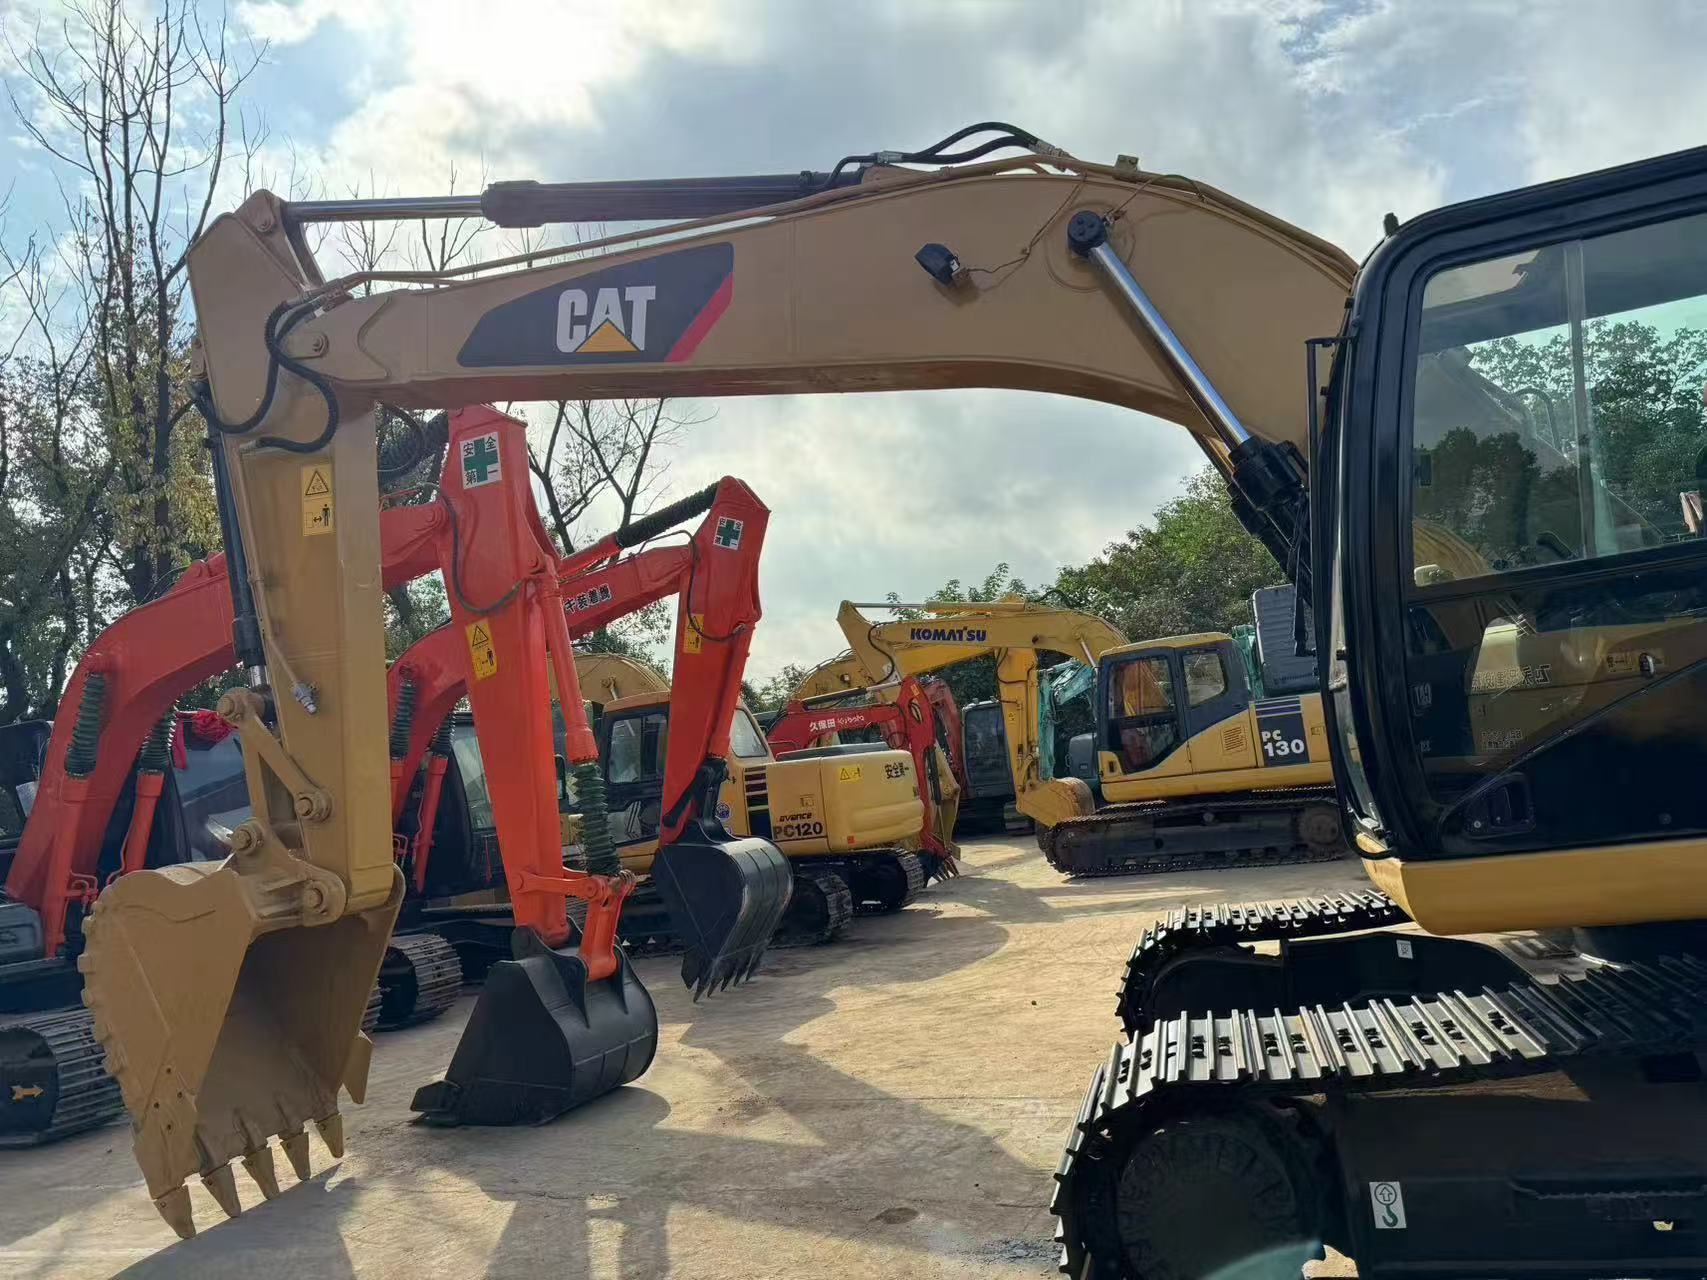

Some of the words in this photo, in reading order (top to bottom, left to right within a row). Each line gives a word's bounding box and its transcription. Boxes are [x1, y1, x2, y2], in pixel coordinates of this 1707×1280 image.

[556, 285, 656, 353] CAT
[464, 436, 497, 456] 安全
[465, 470, 499, 486] 第一
[910, 626, 987, 642] KOMATSU
[809, 717, 836, 732] 久保田
[1261, 729, 1282, 742] PC
[1263, 739, 1305, 757] 130
[773, 822, 824, 840] PC120
